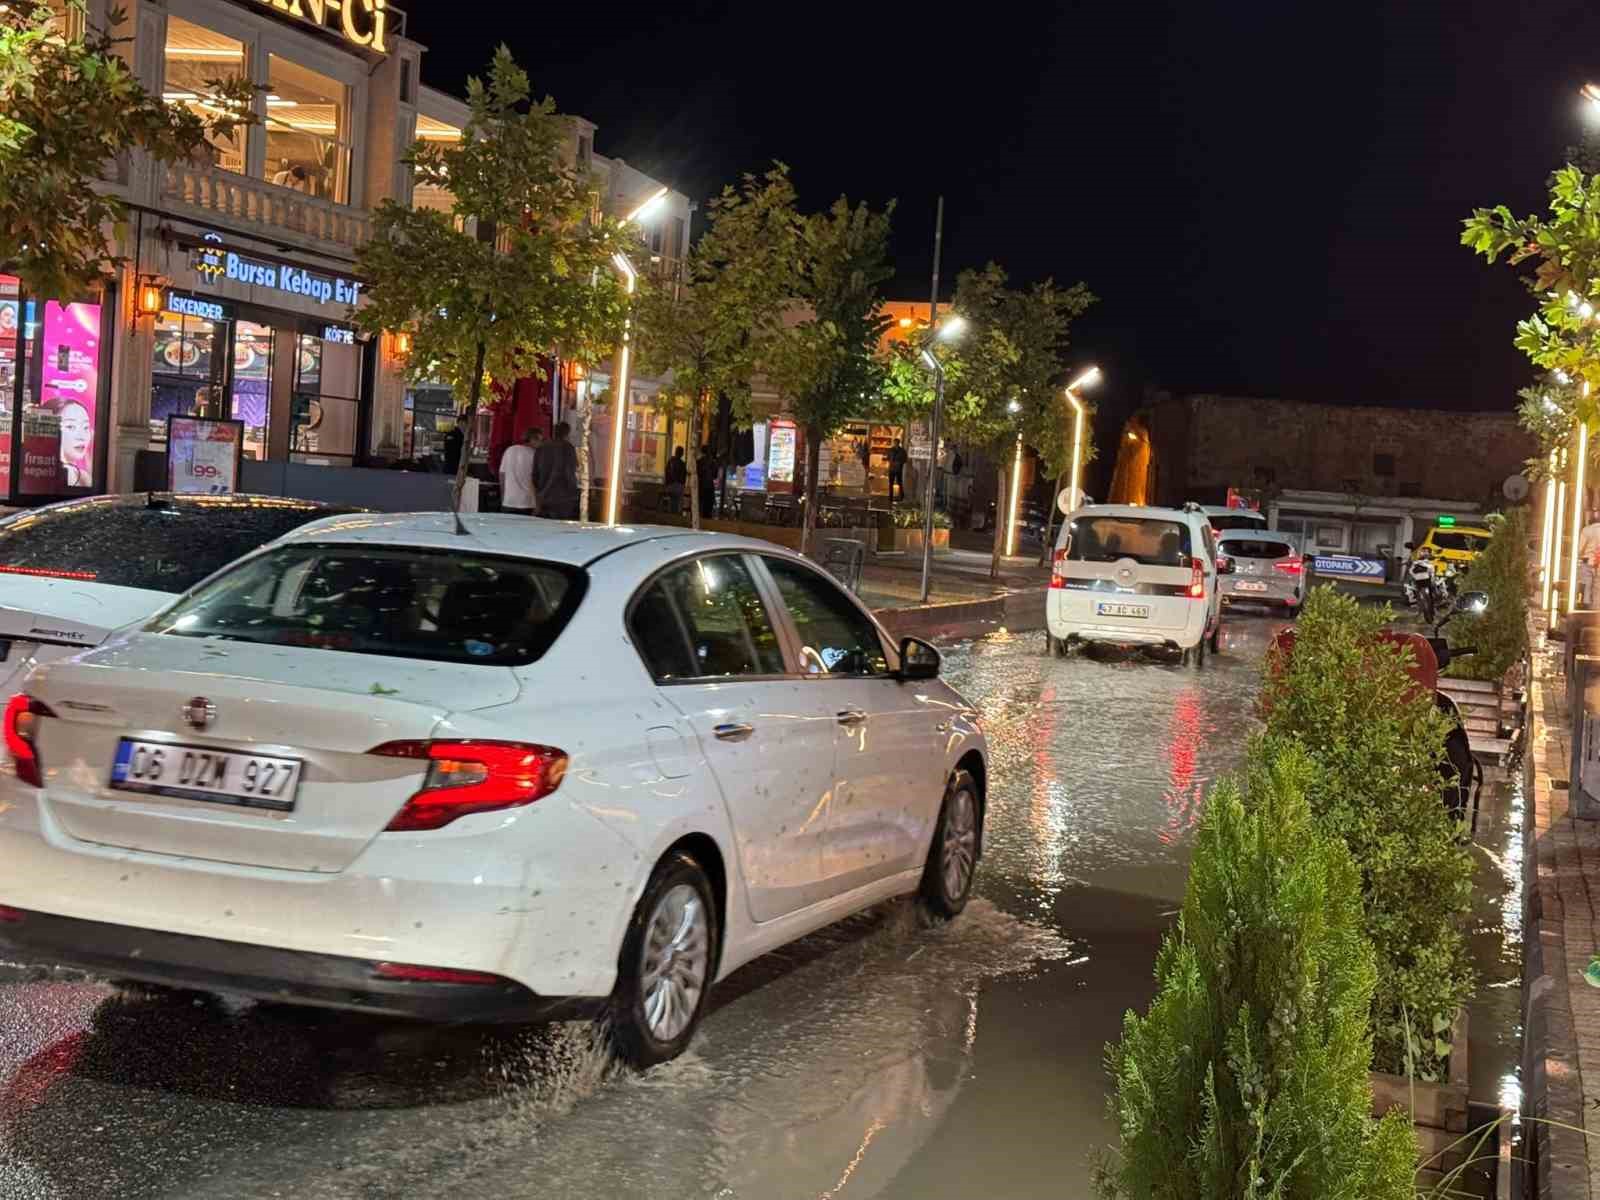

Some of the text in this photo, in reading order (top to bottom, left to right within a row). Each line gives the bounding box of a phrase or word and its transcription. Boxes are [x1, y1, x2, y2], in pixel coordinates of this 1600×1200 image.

[226, 252, 359, 305] Bursa Kebap Evi
[168, 291, 224, 320] İSKENDER
[324, 324, 354, 345] KÖFTE
[1315, 560, 1354, 570] OTOPARK
[132, 746, 165, 781] 06
[241, 759, 296, 797] 927
